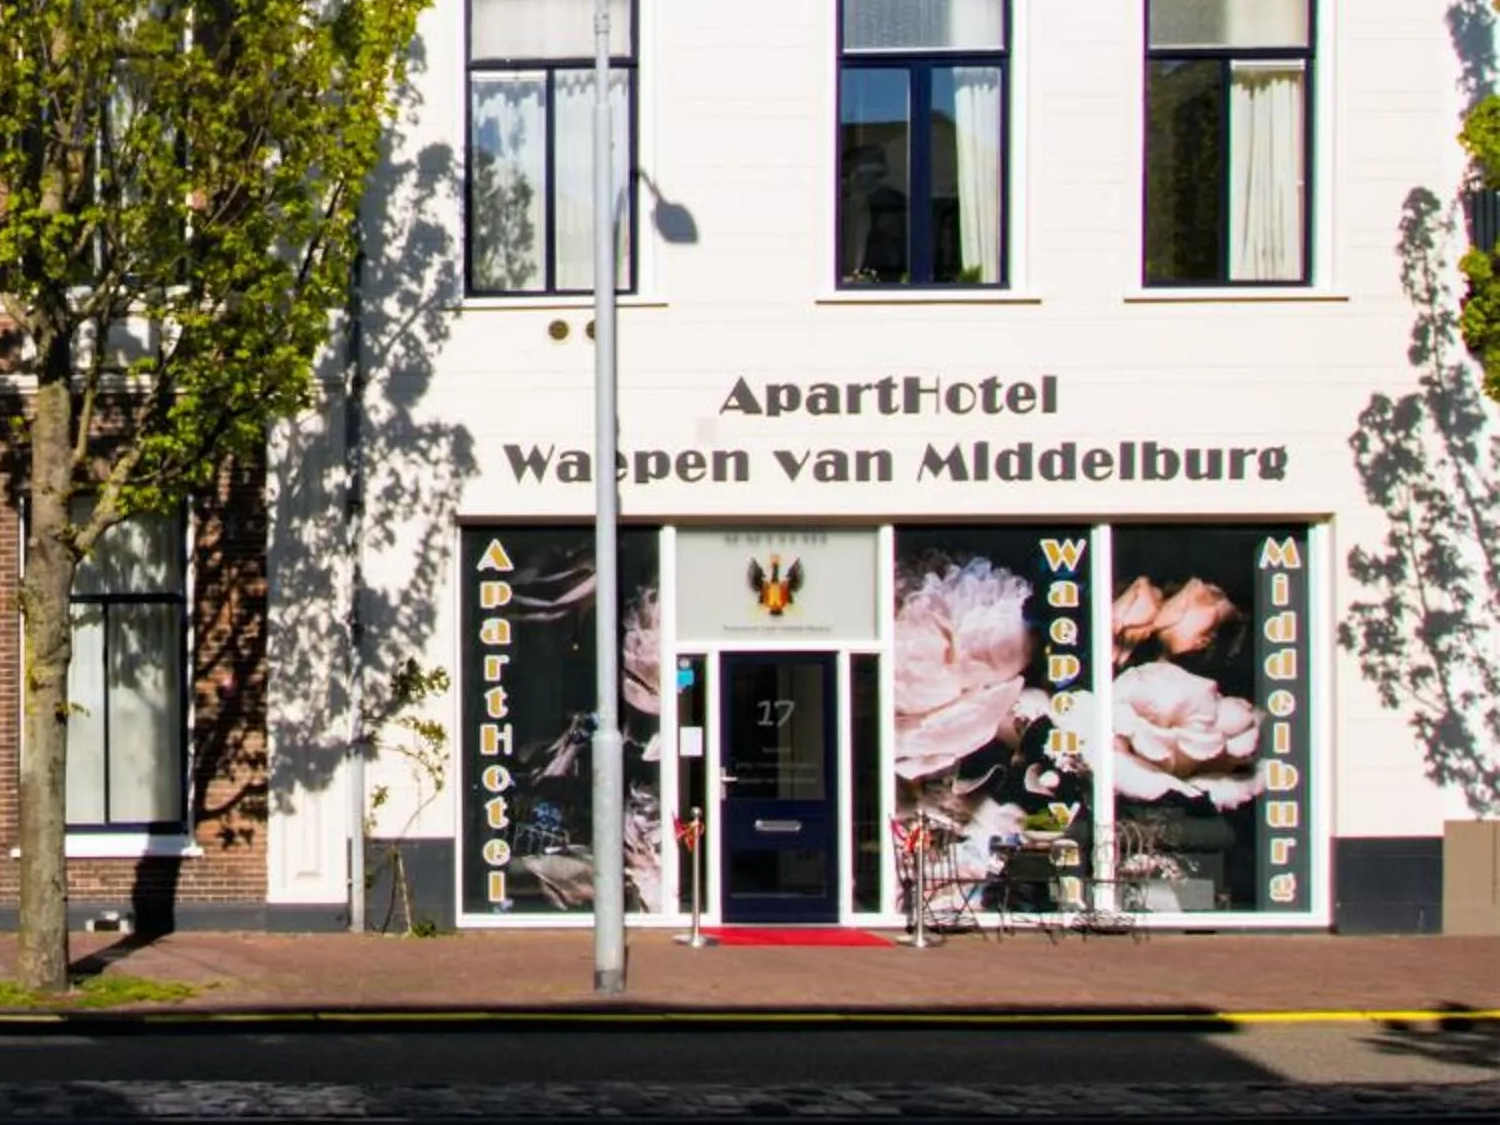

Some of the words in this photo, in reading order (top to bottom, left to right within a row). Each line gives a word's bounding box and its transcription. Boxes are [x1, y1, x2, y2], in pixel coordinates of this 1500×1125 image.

[719, 375, 1058, 416] ApartHotel
[772, 449, 893, 482] van
[1039, 538, 1087, 755] Waepen
[476, 538, 515, 903] ApartHotel
[756, 699, 796, 727] 17
[1259, 535, 1301, 902] Middelburg
